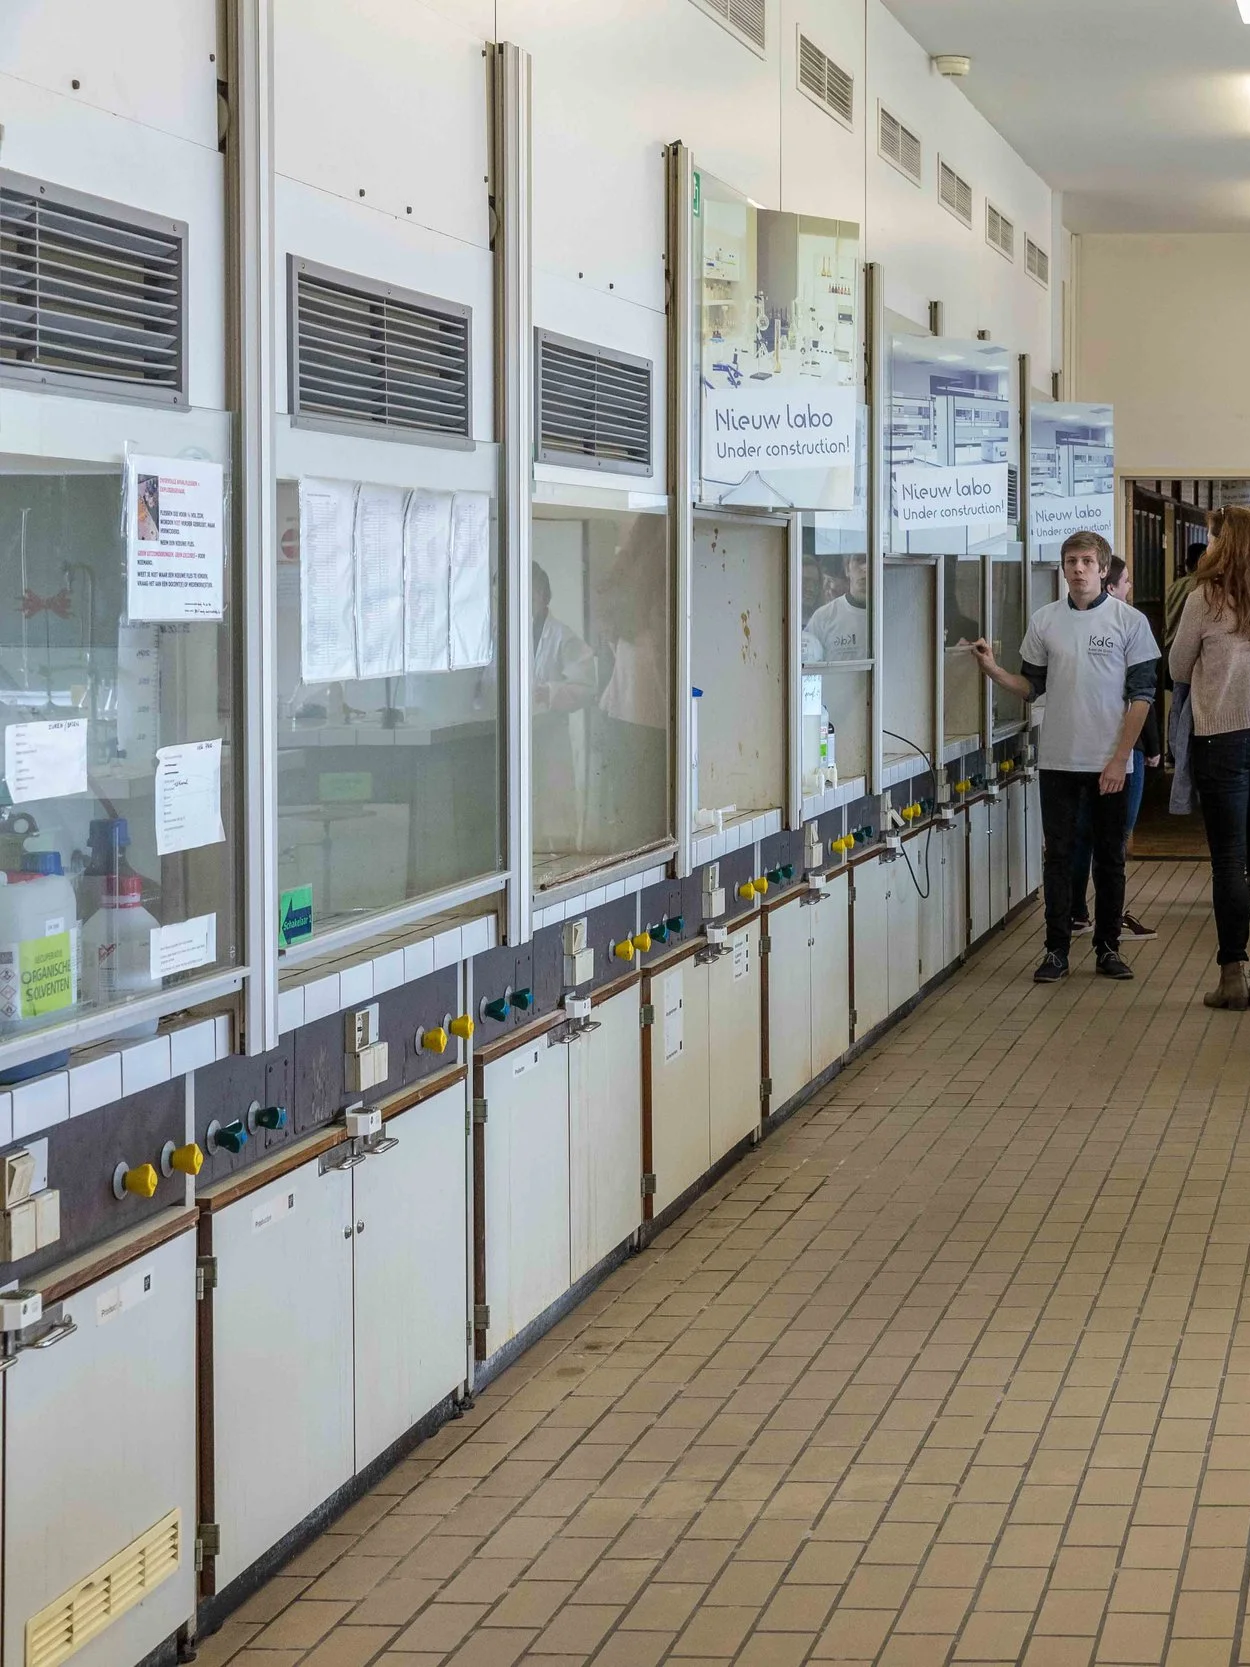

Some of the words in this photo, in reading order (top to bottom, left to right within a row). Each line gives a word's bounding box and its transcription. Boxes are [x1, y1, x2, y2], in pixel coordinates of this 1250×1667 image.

[715, 408, 781, 431] Nieuw
[786, 403, 833, 428] labo
[716, 439, 761, 459] Under
[765, 435, 850, 457] construction!
[902, 483, 952, 500] Nieuw
[956, 477, 992, 496] labo
[903, 505, 938, 520] Under
[940, 499, 1005, 518] construction!
[1035, 509, 1073, 523] Nieuw
[1075, 504, 1102, 519] labo
[1036, 526, 1062, 537] Under
[1089, 635, 1113, 648] KdG
[21, 959, 71, 985] ORGANISCHE
[26, 976, 70, 1002] SOLVENTEN
